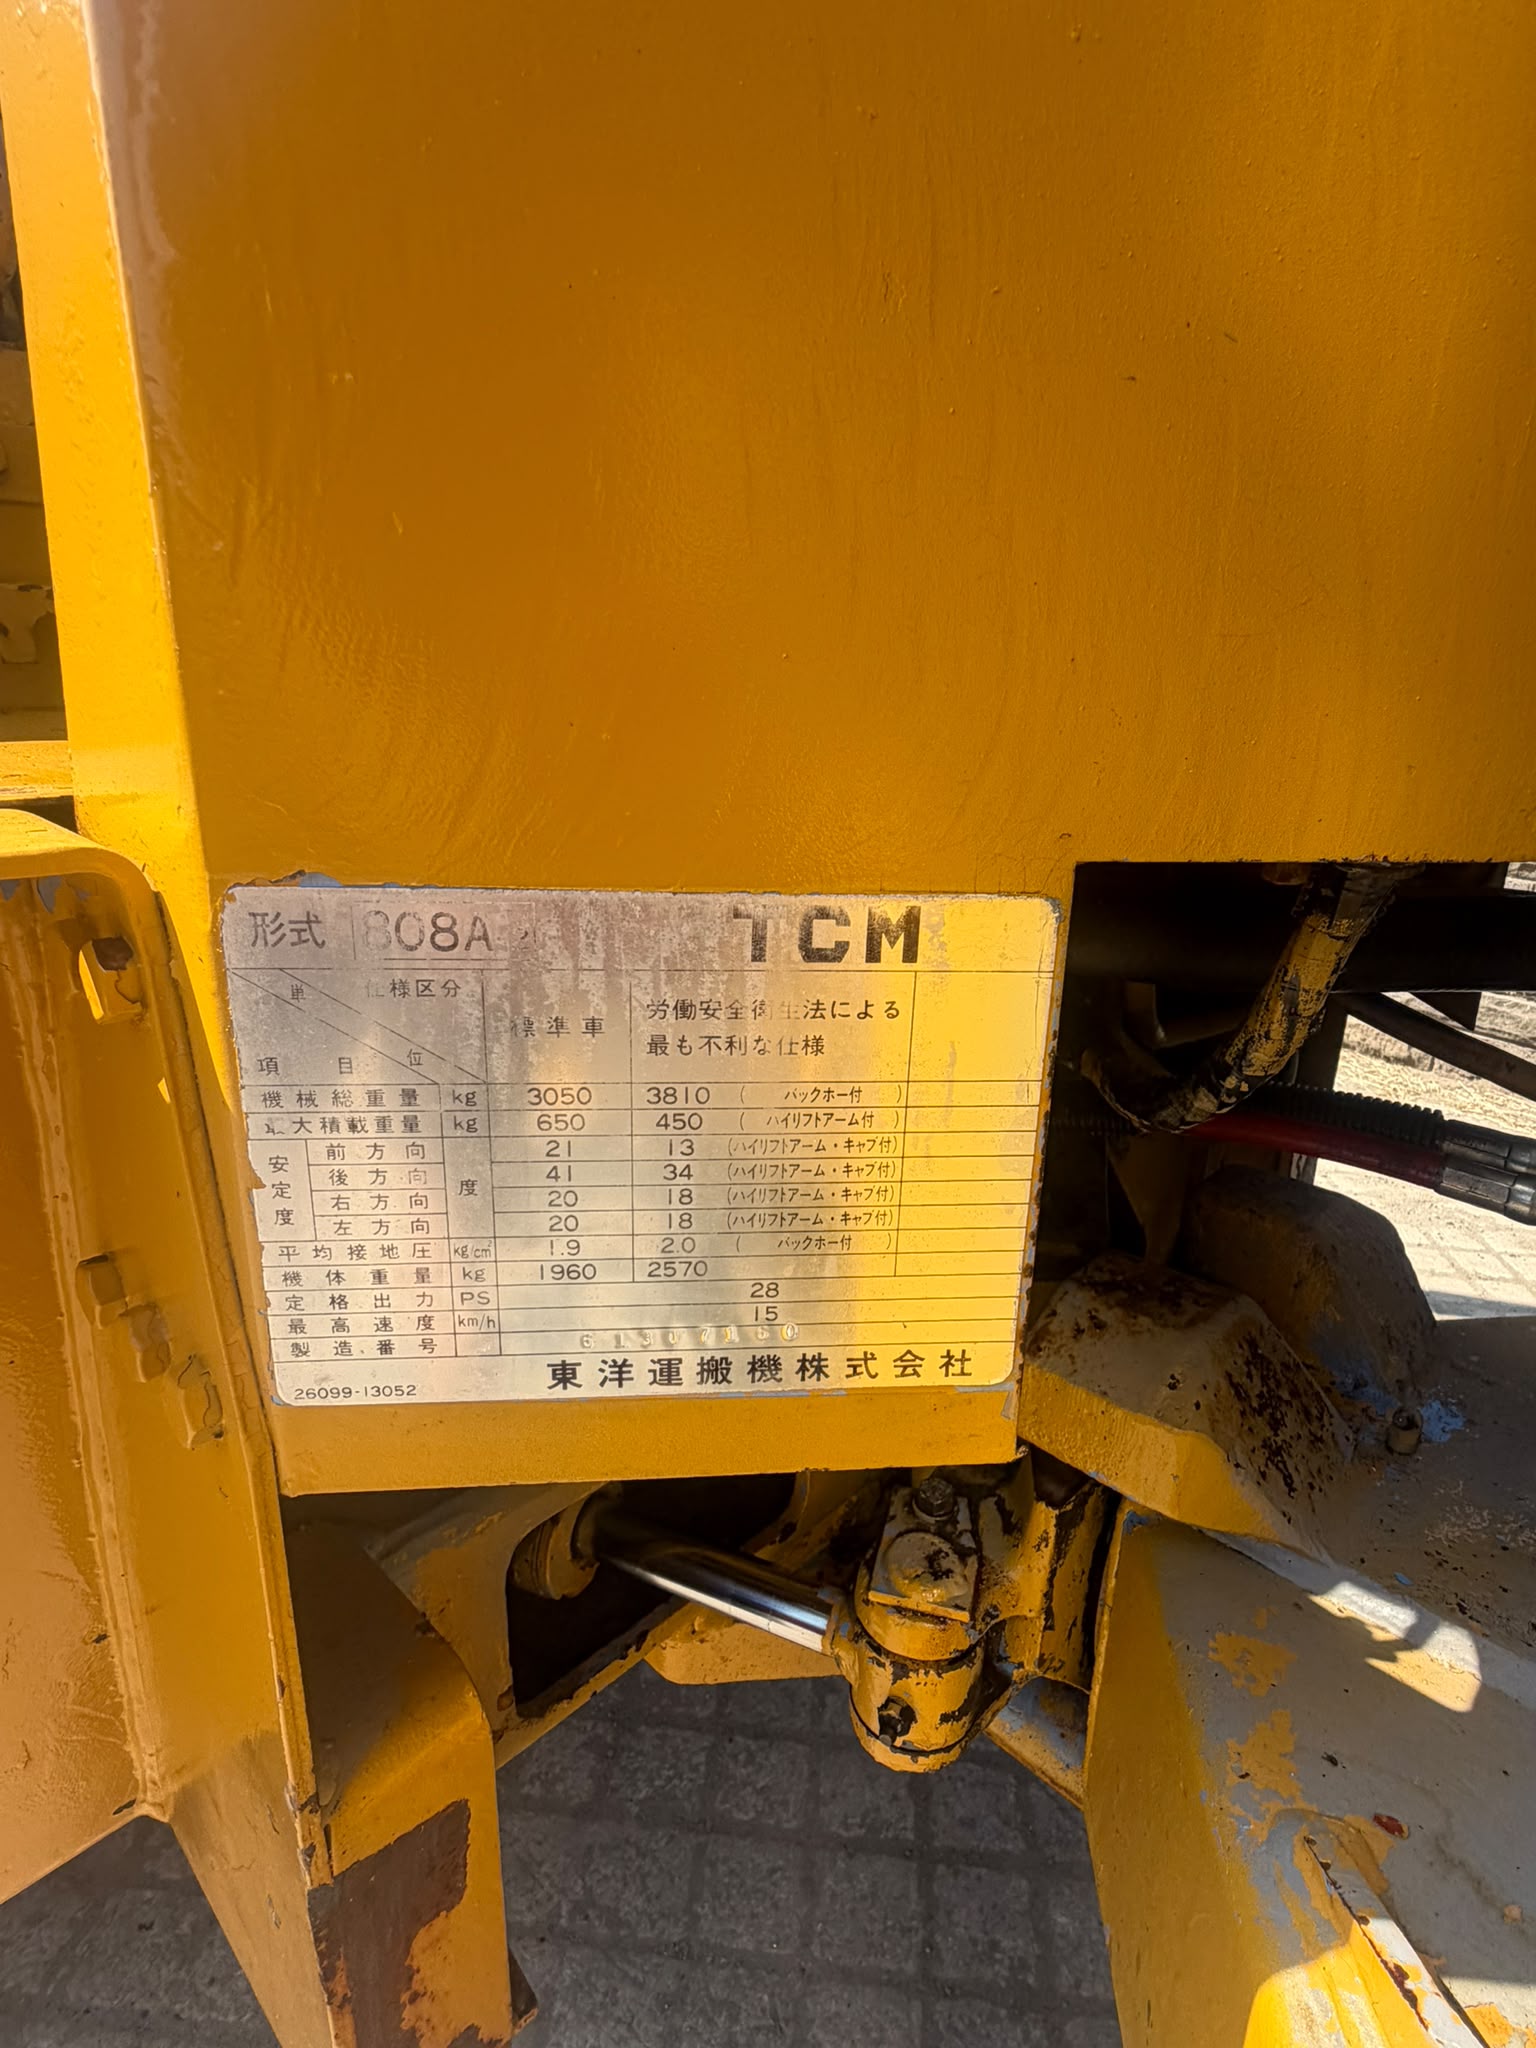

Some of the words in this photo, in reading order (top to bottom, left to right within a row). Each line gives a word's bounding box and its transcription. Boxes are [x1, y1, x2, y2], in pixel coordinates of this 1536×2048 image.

[248, 911, 325, 949] 形式
[732, 904, 921, 964] TCM
[646, 998, 901, 1021] 労働安全衛生法による
[511, 1017, 605, 1037] 標準車
[646, 1034, 825, 1057] 最も不利な仕様
[261, 1088, 420, 1109] 機械総重量
[452, 1089, 477, 1107] kg
[527, 1087, 592, 1106] 3050
[646, 1086, 710, 1105] 3810
[454, 1115, 478, 1134] kg
[537, 1113, 586, 1131] 650
[655, 1112, 703, 1131] 450
[325, 1142, 427, 1161] 前方向
[545, 1140, 572, 1157] 21
[668, 1138, 695, 1156] 13
[329, 1168, 428, 1187] 後方向
[546, 1165, 572, 1182] 41
[662, 1163, 694, 1181] 34
[268, 1155, 294, 1226] 安定度
[458, 1179, 479, 1197] 度
[668, 1188, 694, 1205] 18
[330, 1192, 428, 1211] 右方向
[548, 1190, 578, 1208] 20
[333, 1218, 430, 1236] 左方向
[549, 1214, 579, 1232] 20
[668, 1212, 693, 1229] 18
[278, 1242, 432, 1263] 平均接地圧
[550, 1239, 581, 1257] 1.9
[660, 1237, 696, 1254] 2.0
[281, 1267, 433, 1288] 機体重量
[462, 1266, 486, 1283] kg
[540, 1263, 597, 1281] 1960
[648, 1260, 708, 1278] 2570
[461, 1291, 491, 1305] PS
[750, 1282, 779, 1299] 28
[285, 1291, 434, 1312] 定格出力
[458, 1313, 496, 1331] km/h
[754, 1305, 779, 1322] 15
[288, 1315, 436, 1335] 最高速度
[290, 1338, 438, 1358] 製造番号
[547, 1349, 973, 1390] 東洋運搬機株式会社
[294, 1384, 417, 1400] 26099-13052
